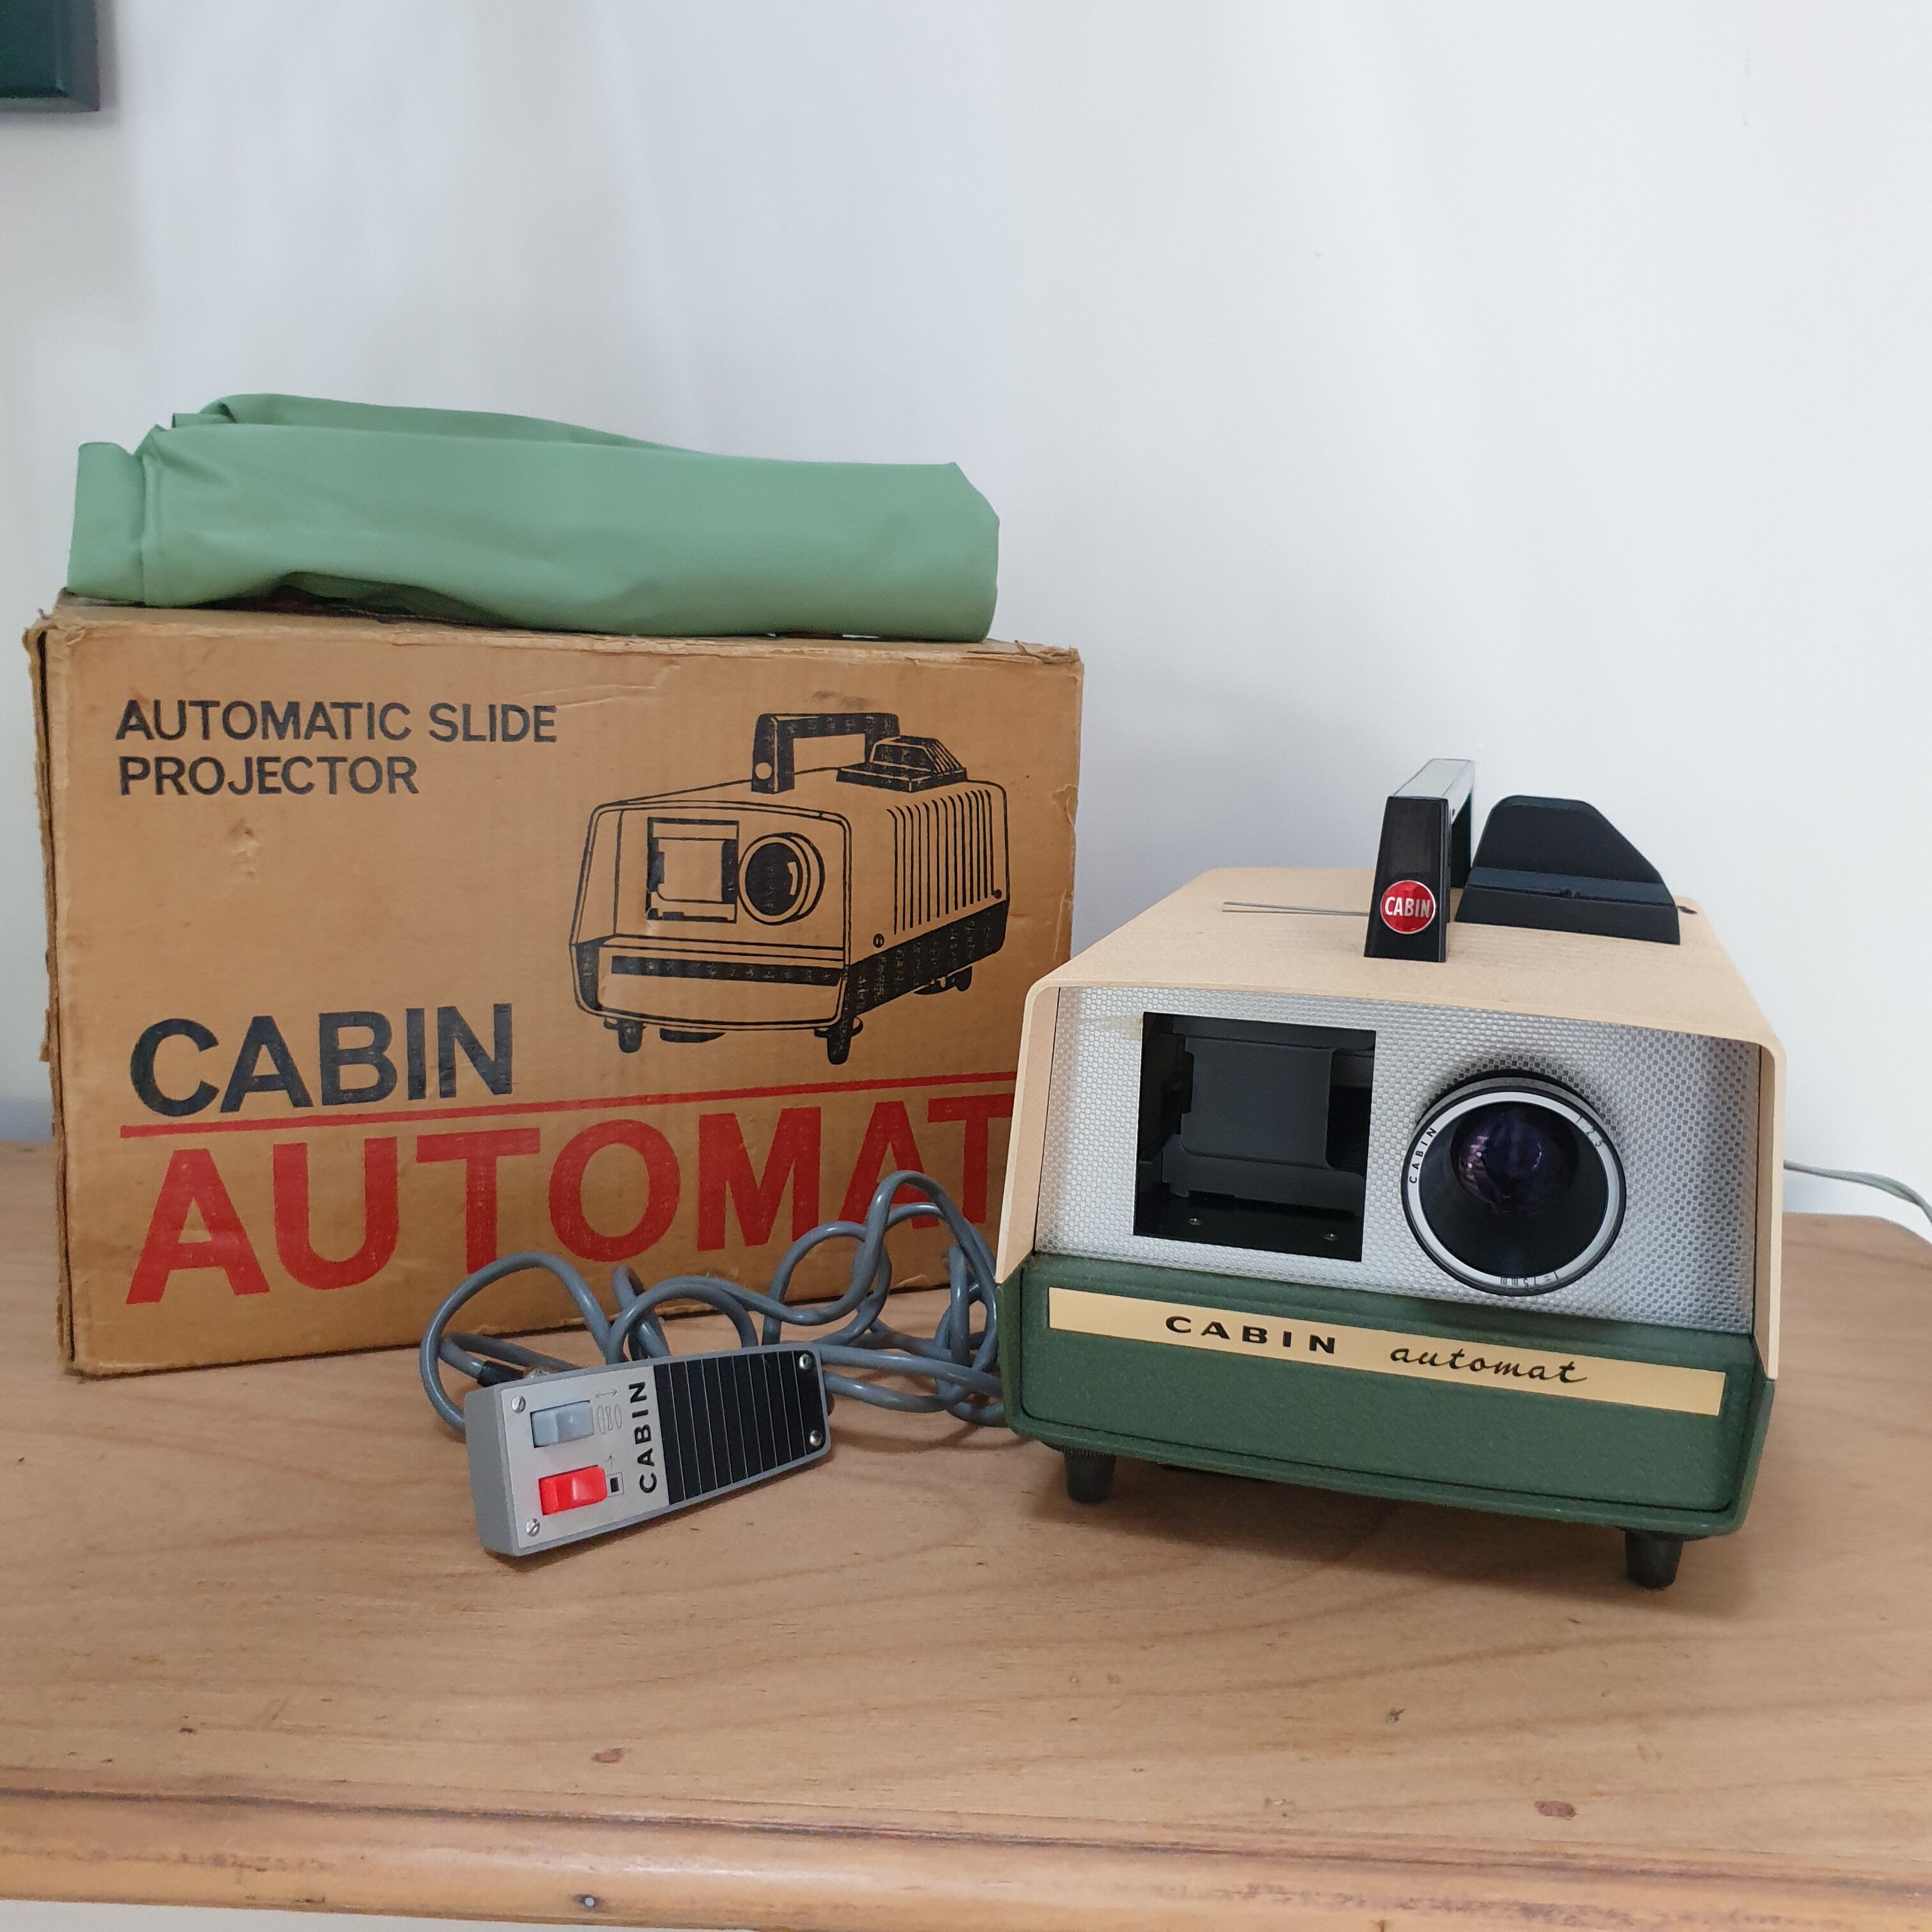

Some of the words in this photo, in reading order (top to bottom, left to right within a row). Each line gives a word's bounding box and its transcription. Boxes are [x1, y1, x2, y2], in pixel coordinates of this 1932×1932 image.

[116, 699, 413, 742] AUTOMATIC
[428, 702, 558, 743] SLIDE
[119, 755, 420, 796] PROJECTOR
[1384, 896, 1431, 918] CABIN
[130, 1002, 513, 1117] CABIN
[1409, 1126, 1437, 1184] CABIN
[126, 1092, 1015, 1305] AUTOMAT
[1165, 1316, 1337, 1355] CABIN
[1390, 1347, 1588, 1384] automat
[628, 1381, 658, 1494] CABIN
